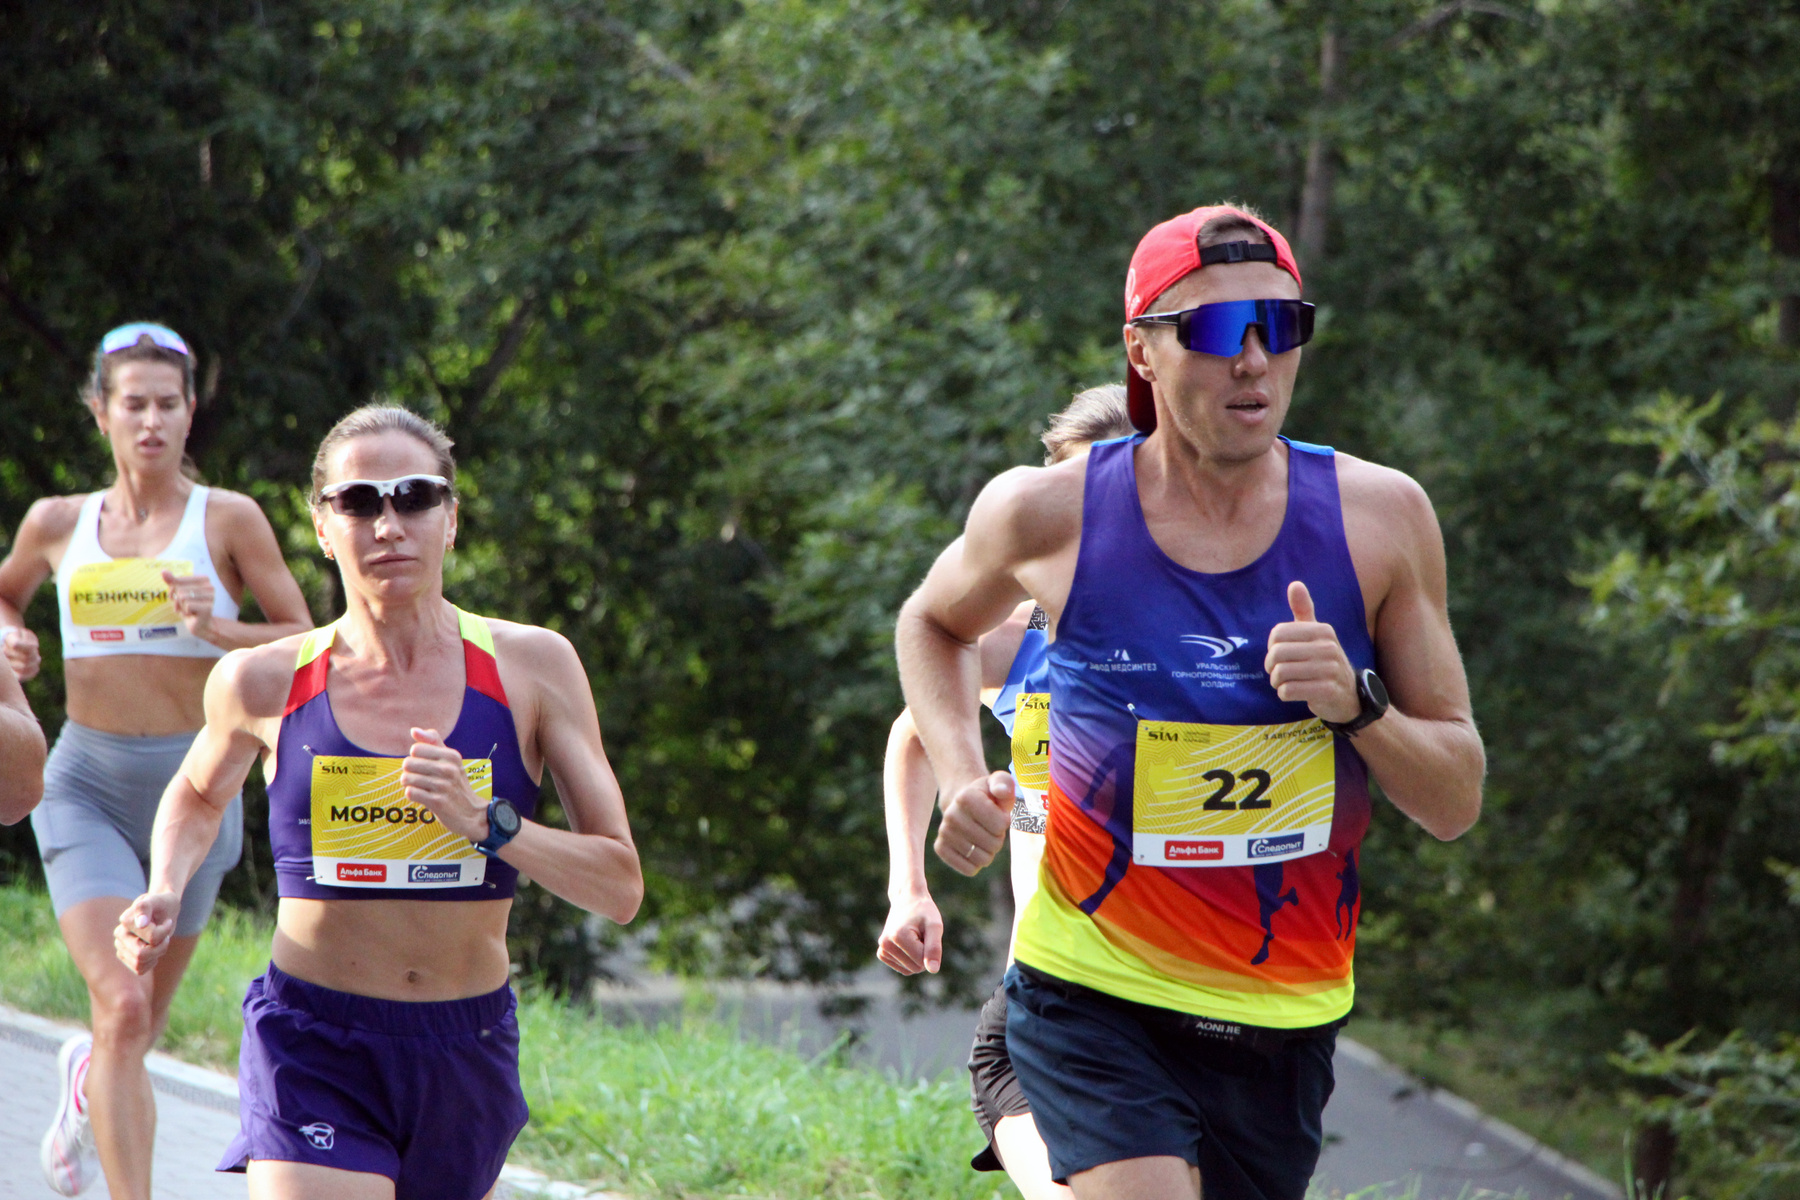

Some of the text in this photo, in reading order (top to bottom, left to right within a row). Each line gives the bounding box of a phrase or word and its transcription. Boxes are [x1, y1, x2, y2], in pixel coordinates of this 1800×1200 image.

[75, 590, 168, 604] РЕЗНИЧЕН
[1196, 662, 1240, 670] УРАЛЬСКИЙ
[1201, 769, 1272, 811] 22
[1168, 845, 1219, 856] Альфа Банк
[1257, 841, 1302, 854] Следопыт
[340, 867, 383, 877] Альфа Банк
[417, 870, 458, 880] Следопыт
